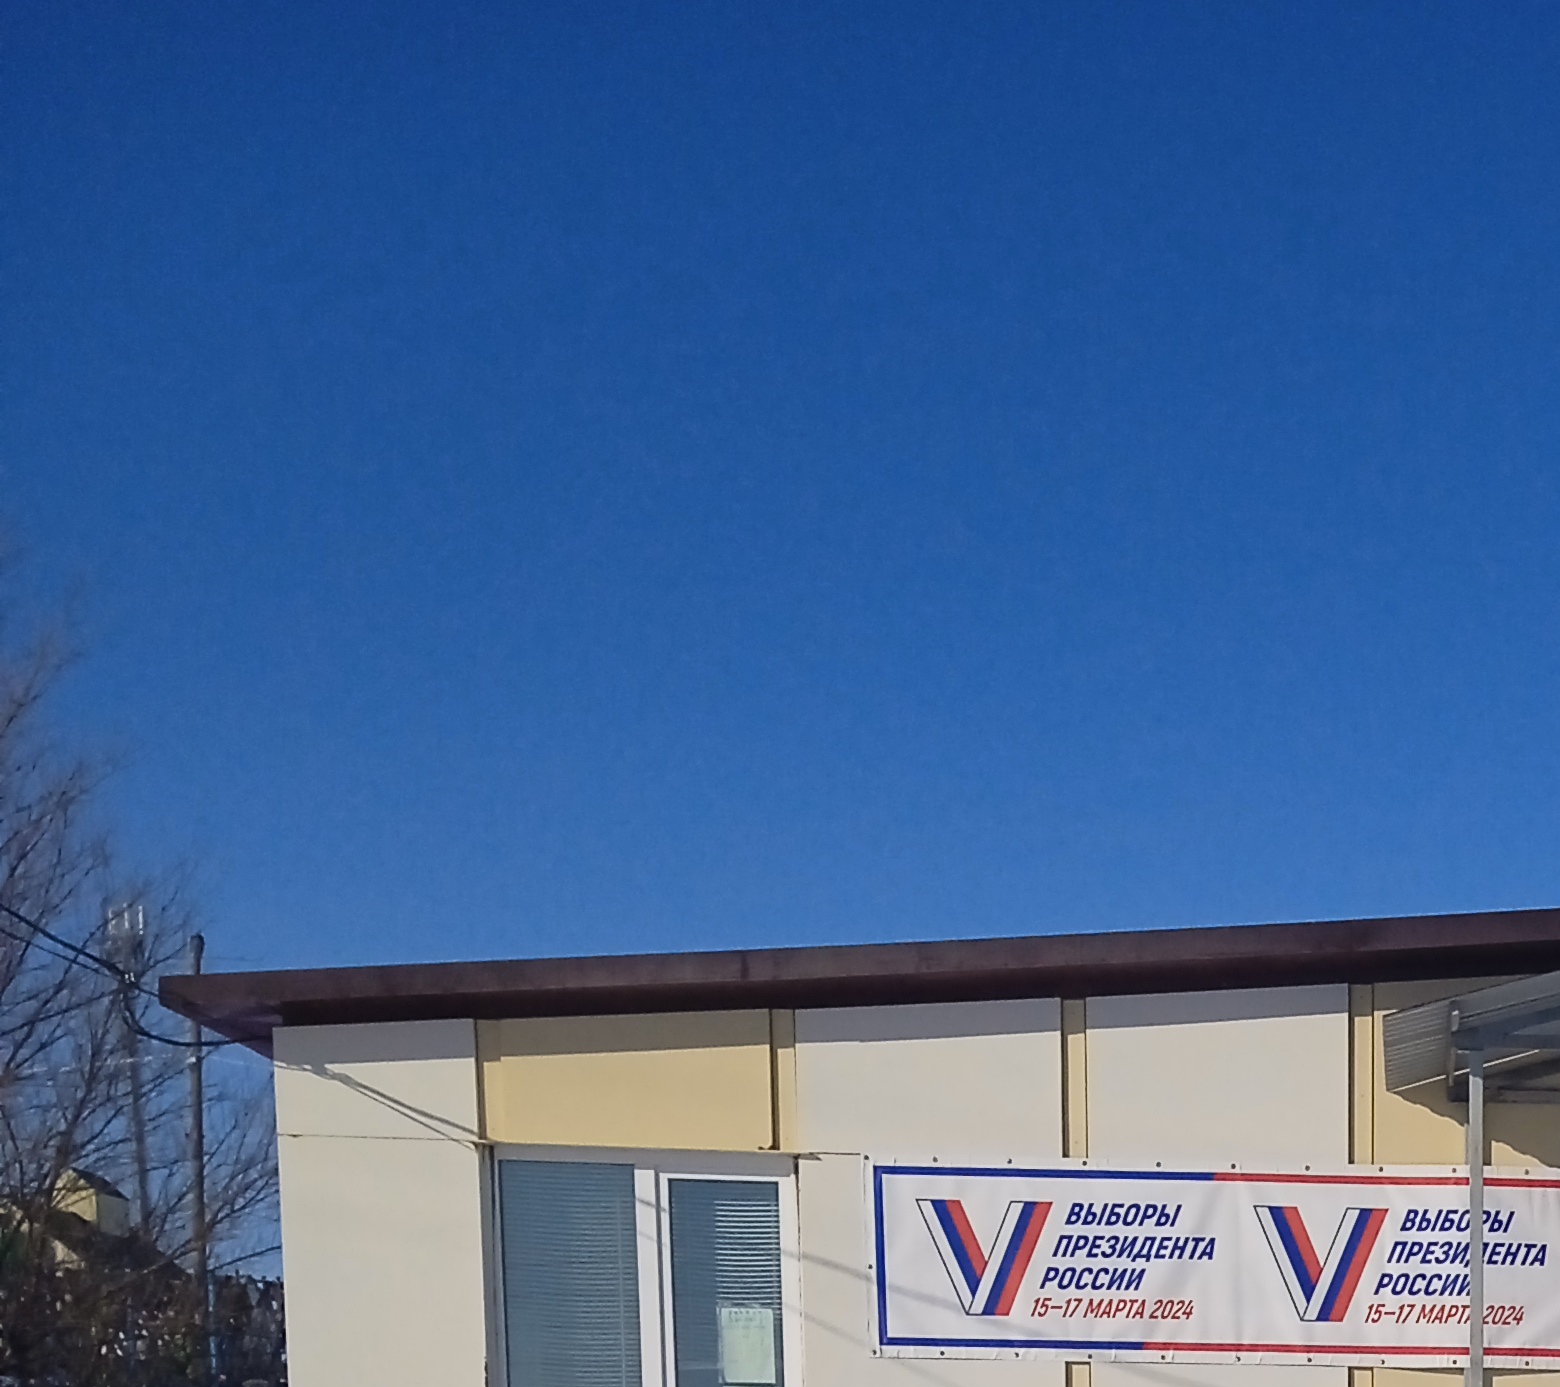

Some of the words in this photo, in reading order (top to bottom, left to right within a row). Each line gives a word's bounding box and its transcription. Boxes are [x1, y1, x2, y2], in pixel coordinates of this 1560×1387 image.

[1064, 1202, 1183, 1227] ВЫБОРЫ
[1051, 1234, 1216, 1263] ПРЕЗИДЕНТА
[1039, 1266, 1147, 1291] РОССИИ
[1082, 1298, 1147, 1319] МАРТА
[1148, 1299, 1194, 1320] 2024
[1482, 1304, 1525, 1326] 2024
